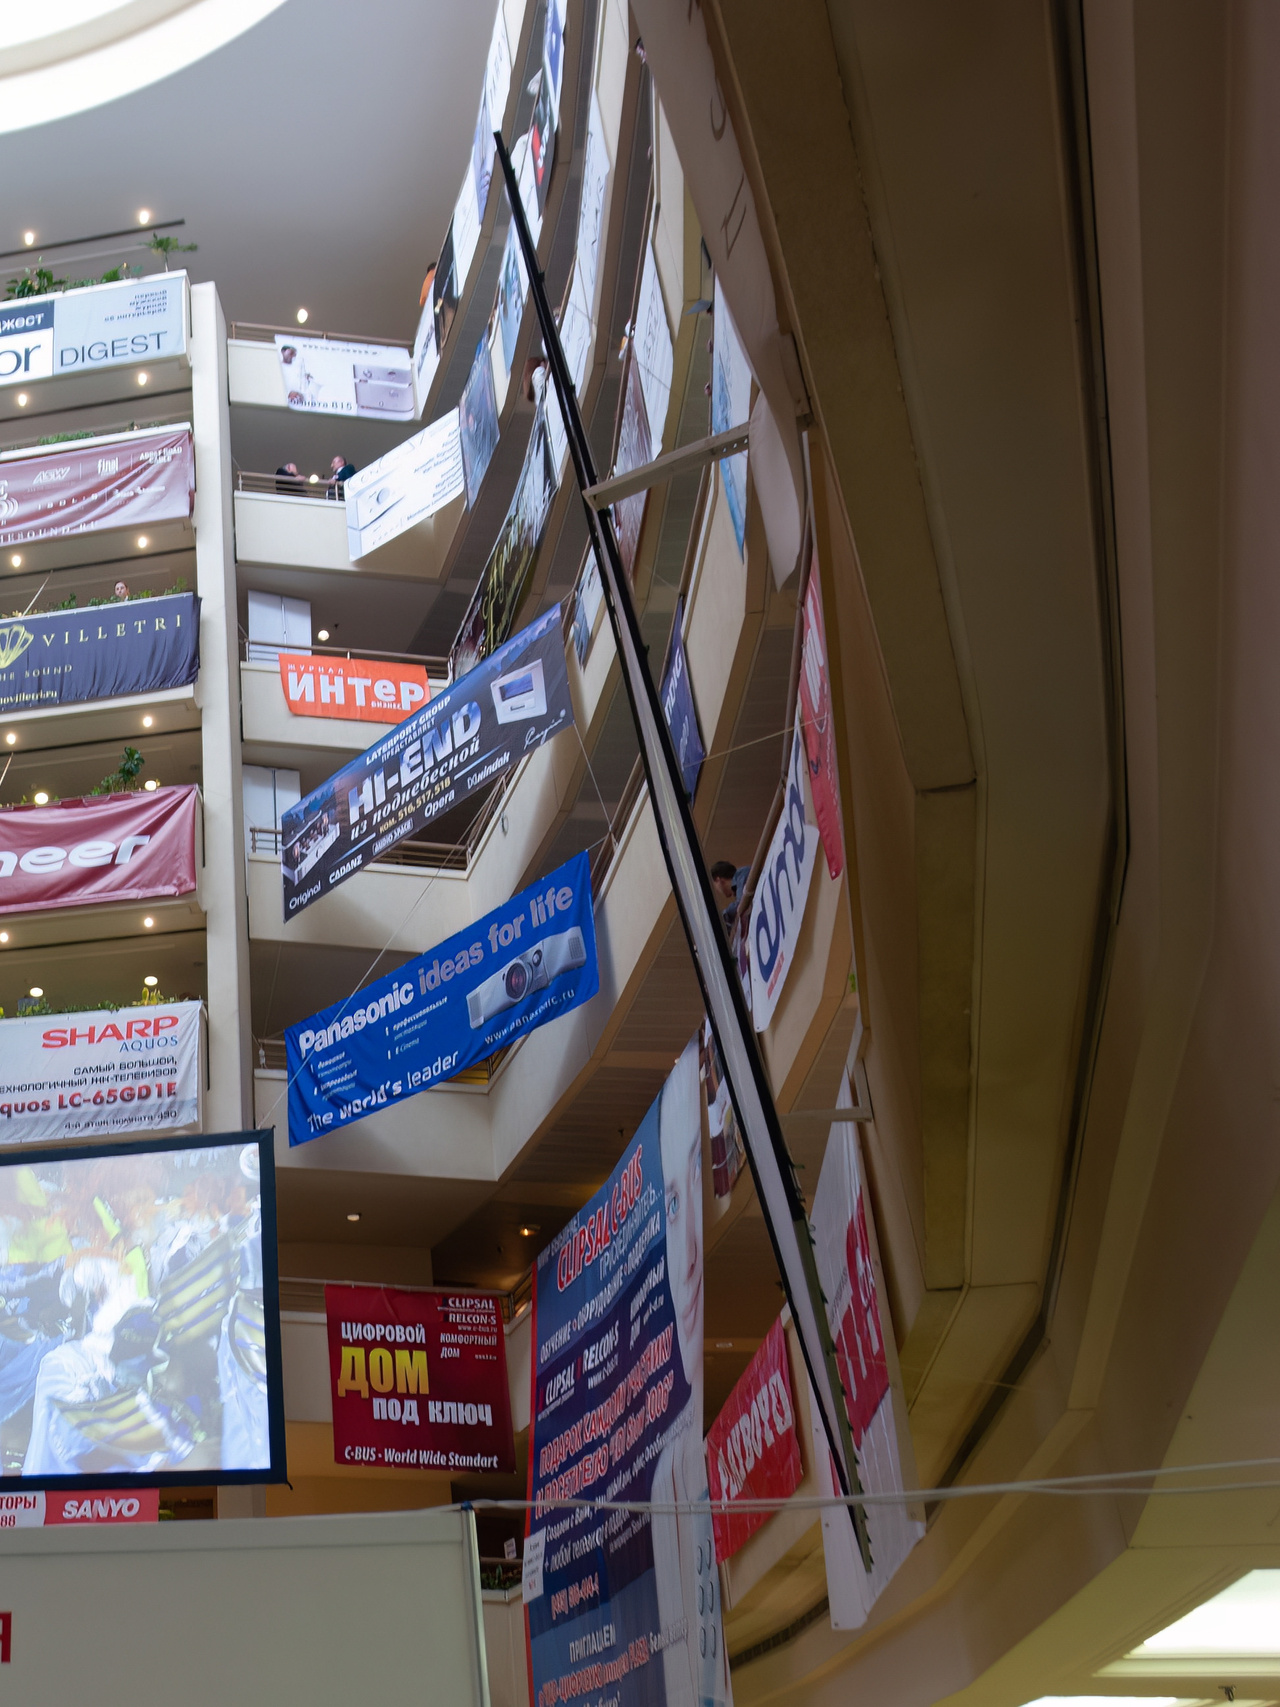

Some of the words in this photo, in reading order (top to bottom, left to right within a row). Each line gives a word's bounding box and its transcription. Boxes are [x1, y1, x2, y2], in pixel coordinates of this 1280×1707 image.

[59, 331, 169, 368] DIGEST
[42, 614, 182, 648] VILLETRI
[25, 663, 74, 679] SOUND
[287, 663, 345, 675] ЖУРНАЛ
[419, 696, 451, 725] GROUP
[349, 701, 482, 824] HI-END
[372, 736, 480, 826] поднебесной
[424, 790, 456, 819] Opera
[289, 881, 322, 910] Original
[299, 981, 414, 1059] Panasonic
[419, 941, 484, 995] ideas
[487, 912, 525, 953] for
[529, 886, 573, 928] life
[41, 1015, 179, 1049] SHARP
[119, 1035, 179, 1053] AQUOS
[73, 1060, 115, 1076] САМЫЙ
[118, 1055, 178, 1072] БОЛЬШОЙ,
[57, 1081, 178, 1109] LC-65GD1E
[307, 1111, 333, 1133] The
[339, 1078, 402, 1119] world's
[408, 1051, 458, 1090] leader
[557, 1200, 610, 1293] CLIPSAL
[448, 1297, 495, 1310] CLIPSAL
[341, 1321, 426, 1344] ЦИФРОВОЙ
[449, 1313, 497, 1326] RELCON-S
[440, 1332, 497, 1346] КОМФОРТНЫЙ
[441, 1347, 460, 1359] ДОМ
[337, 1345, 430, 1399] ДОМ
[545, 1362, 575, 1406] CLIPSAL
[373, 1397, 420, 1426] ПОД
[428, 1400, 493, 1427] КЛЮЧ
[384, 1448, 417, 1465] World
[419, 1450, 447, 1467] Wide
[448, 1452, 498, 1469] Standart
[62, 1498, 140, 1520] SANYO
